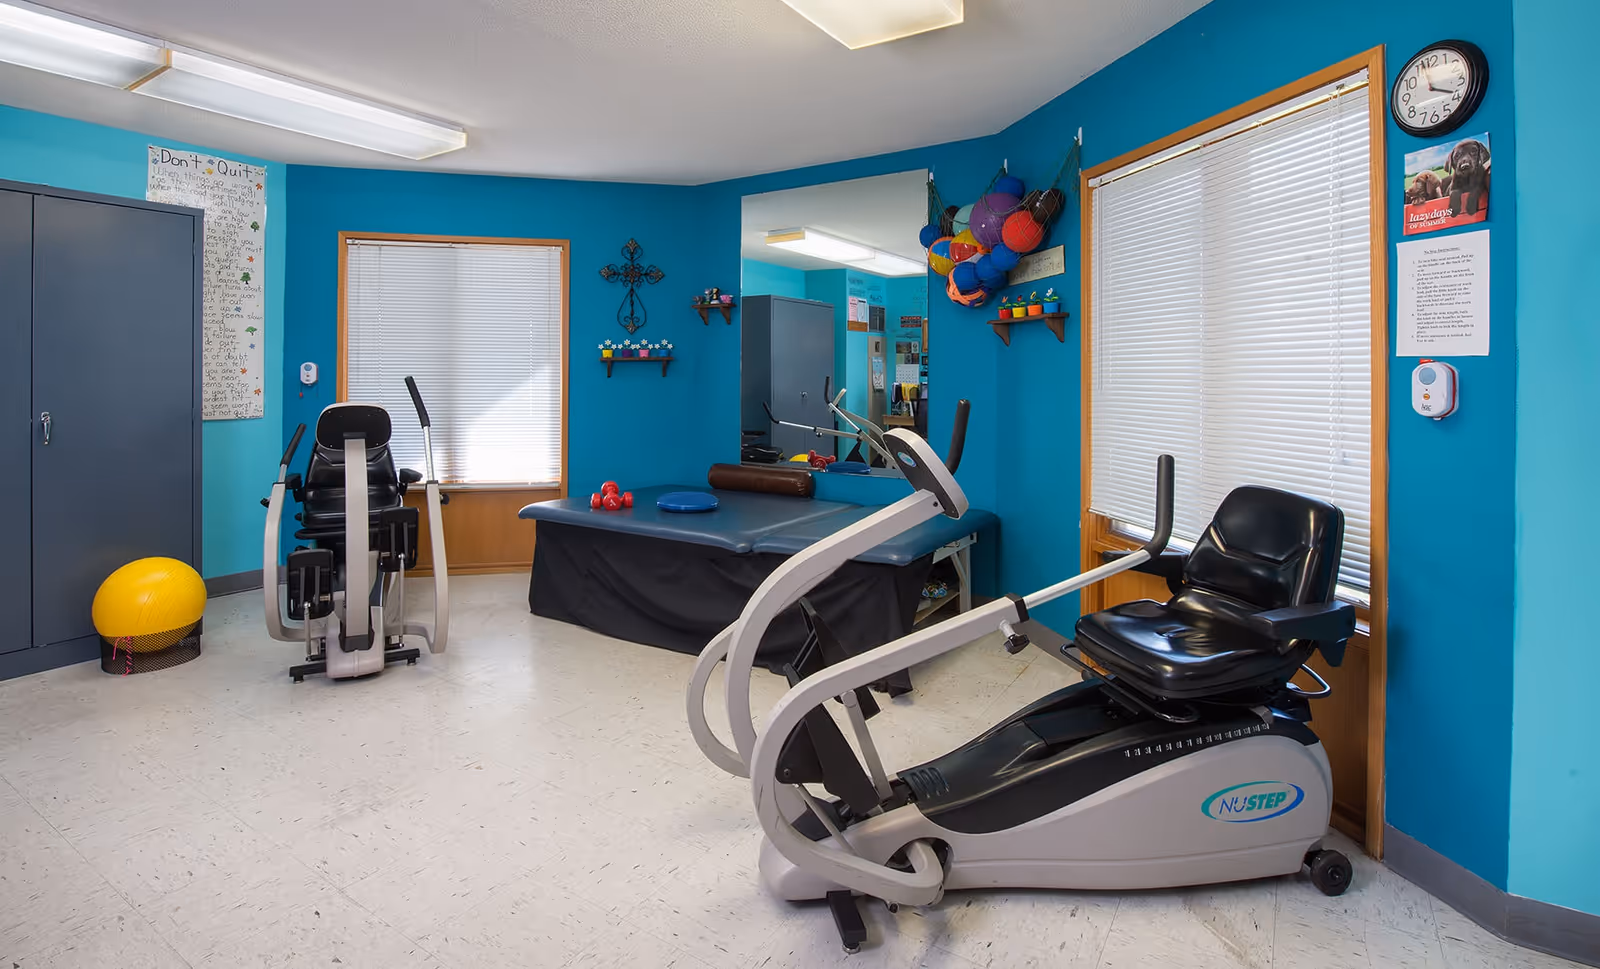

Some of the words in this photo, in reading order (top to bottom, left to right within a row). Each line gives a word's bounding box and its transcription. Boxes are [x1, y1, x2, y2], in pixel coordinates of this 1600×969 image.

[1442, 53, 1448, 65] 1
[1404, 76, 1417, 91] 10
[1457, 72, 1466, 87] 3
[1402, 92, 1411, 106] 9
[1452, 89, 1461, 102] 4
[1408, 105, 1416, 119] 8
[1430, 110, 1440, 124] 6
[1442, 103, 1452, 118] 5
[1420, 111, 1428, 126] 7
[161, 148, 202, 169] Don't
[218, 160, 253, 178] Quit
[184, 172, 209, 184] things
